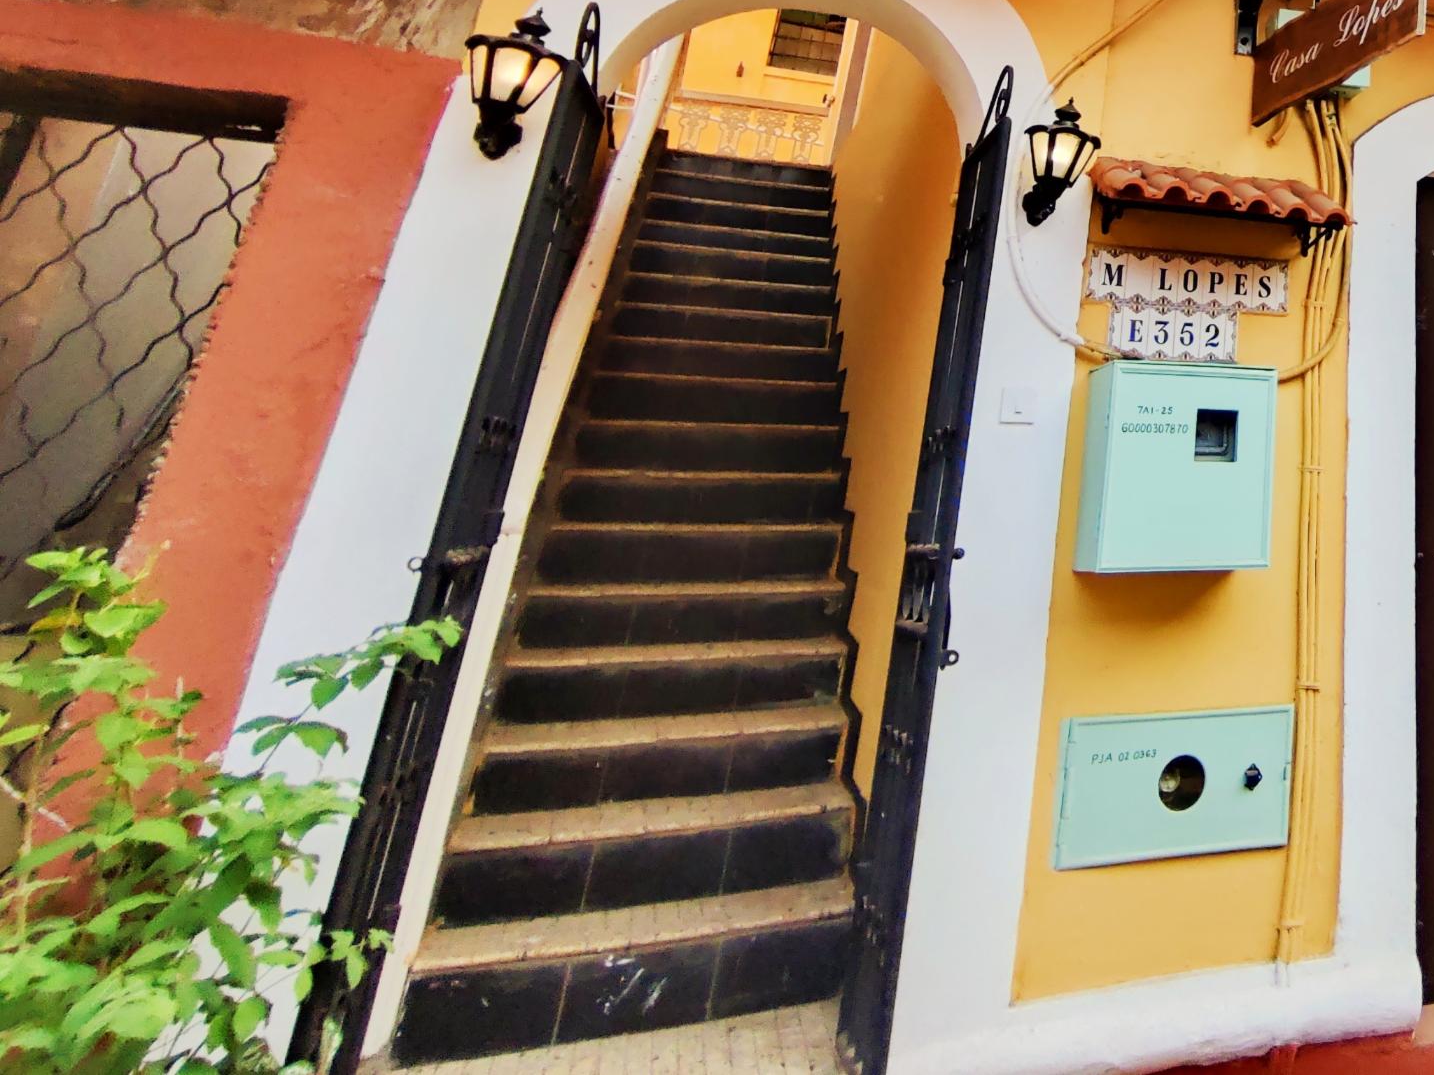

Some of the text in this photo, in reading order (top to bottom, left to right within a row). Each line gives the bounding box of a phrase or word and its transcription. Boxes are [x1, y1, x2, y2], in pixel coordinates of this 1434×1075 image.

[1269, 41, 1324, 84] Casa
[1101, 262, 1272, 299] M LOPES
[1128, 319, 1220, 348] E352
